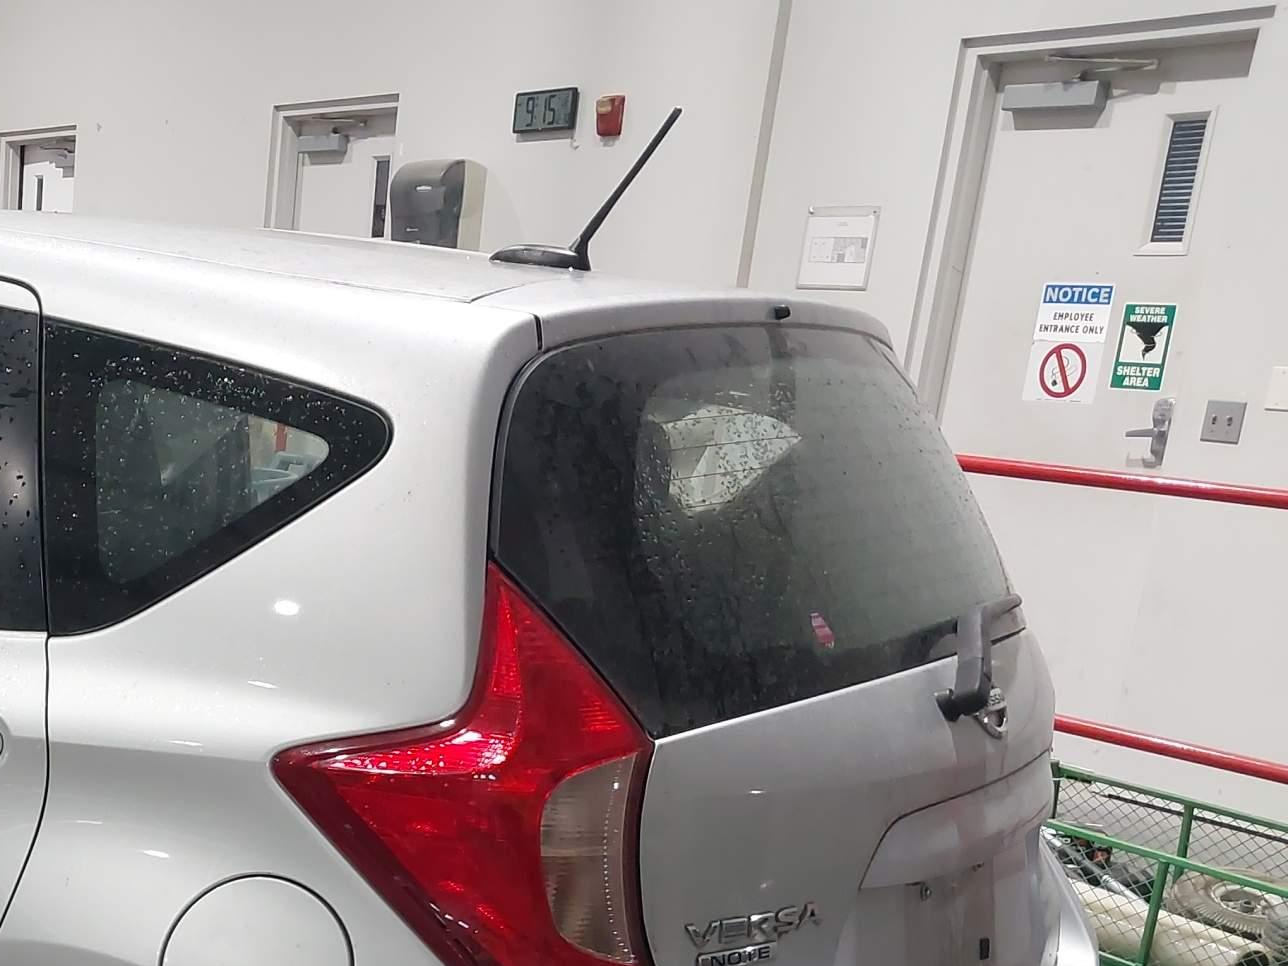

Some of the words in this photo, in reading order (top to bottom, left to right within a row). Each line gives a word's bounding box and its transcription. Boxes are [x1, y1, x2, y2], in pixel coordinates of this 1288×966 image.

[1045, 286, 1111, 304] NOTICE
[1135, 306, 1166, 315] SEVERE
[1053, 311, 1095, 322] EMPLOYEE
[1130, 314, 1168, 323] WEATHER
[1039, 323, 1081, 334] ENTRANCE
[1082, 325, 1105, 335] ONLY
[1116, 365, 1161, 378] SHELTER
[1123, 376, 1149, 387] AREA
[684, 901, 821, 948] VERSA
